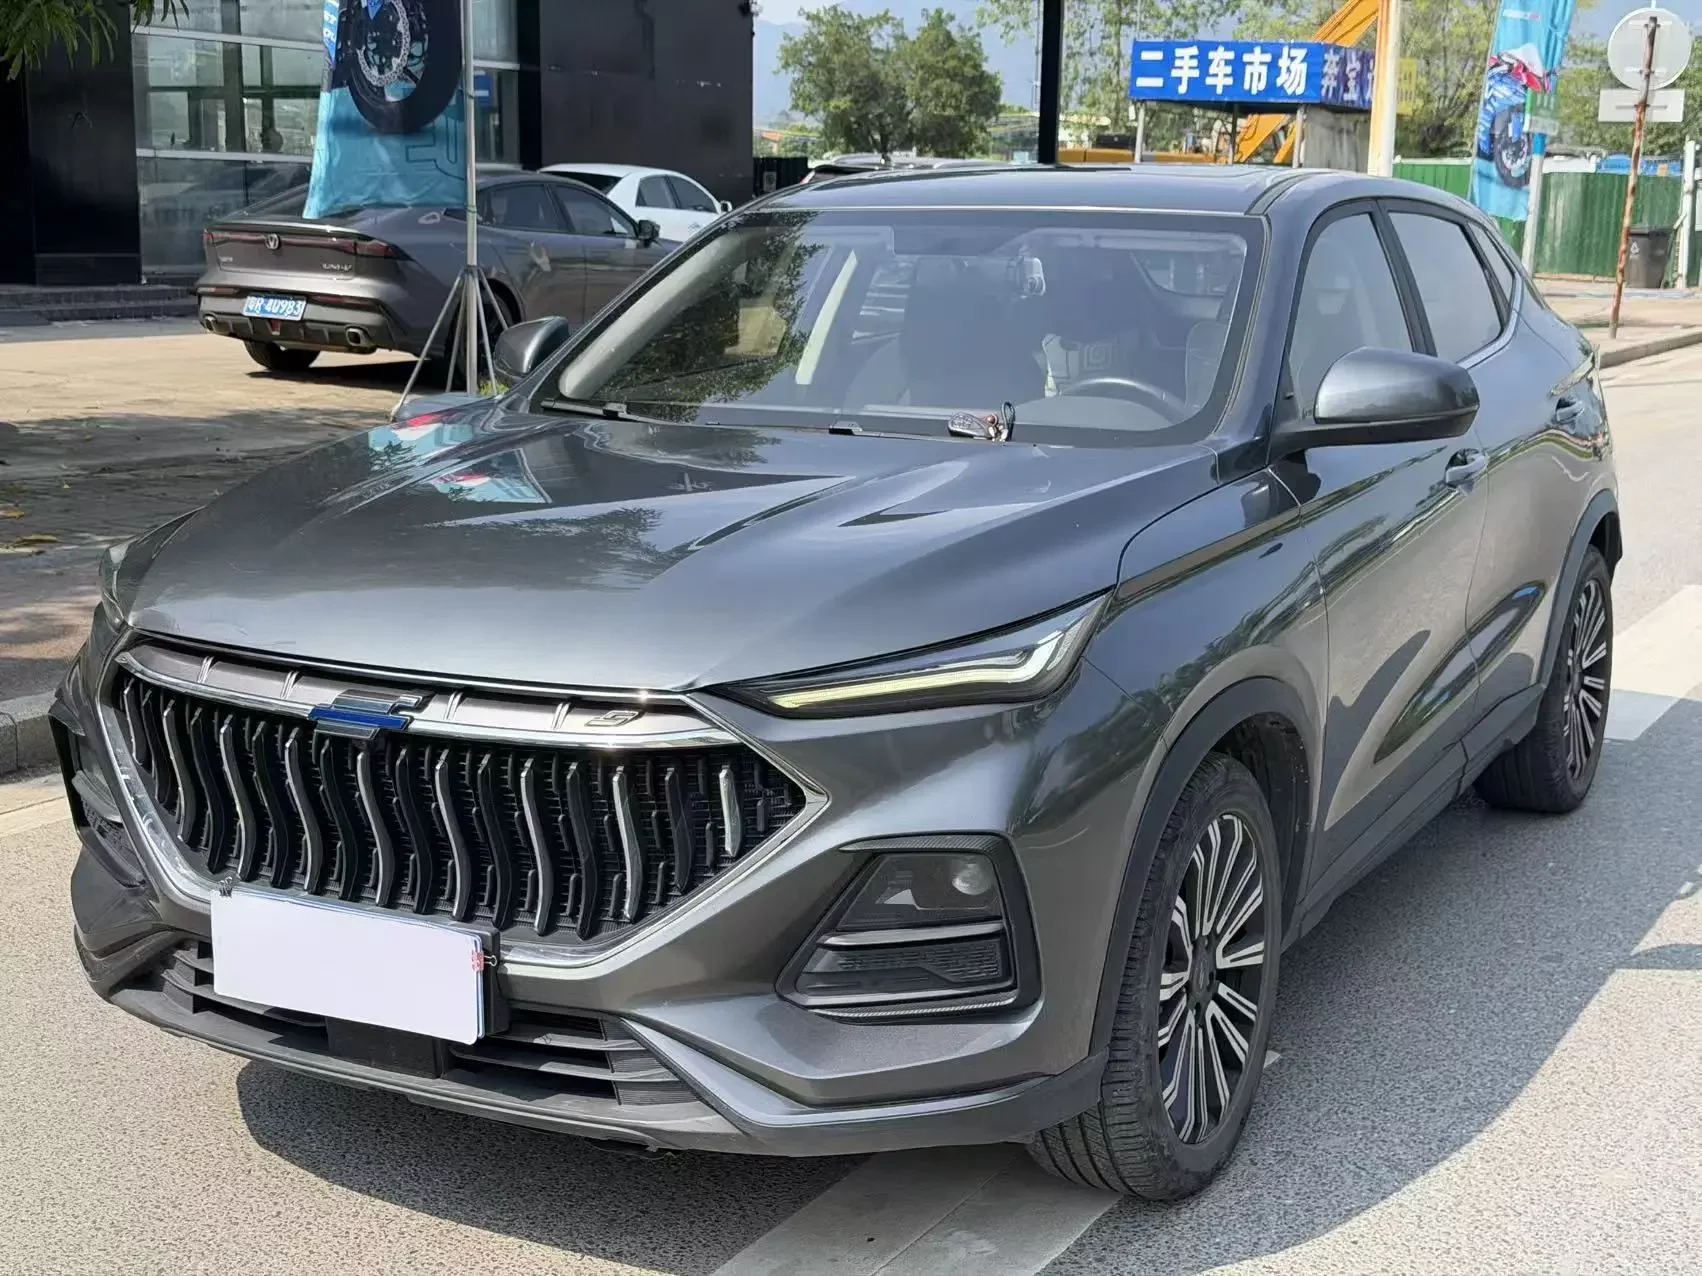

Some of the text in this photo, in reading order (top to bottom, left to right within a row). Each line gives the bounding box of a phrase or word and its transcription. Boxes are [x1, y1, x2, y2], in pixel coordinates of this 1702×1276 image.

[1136, 45, 1308, 95] 二手车市场
